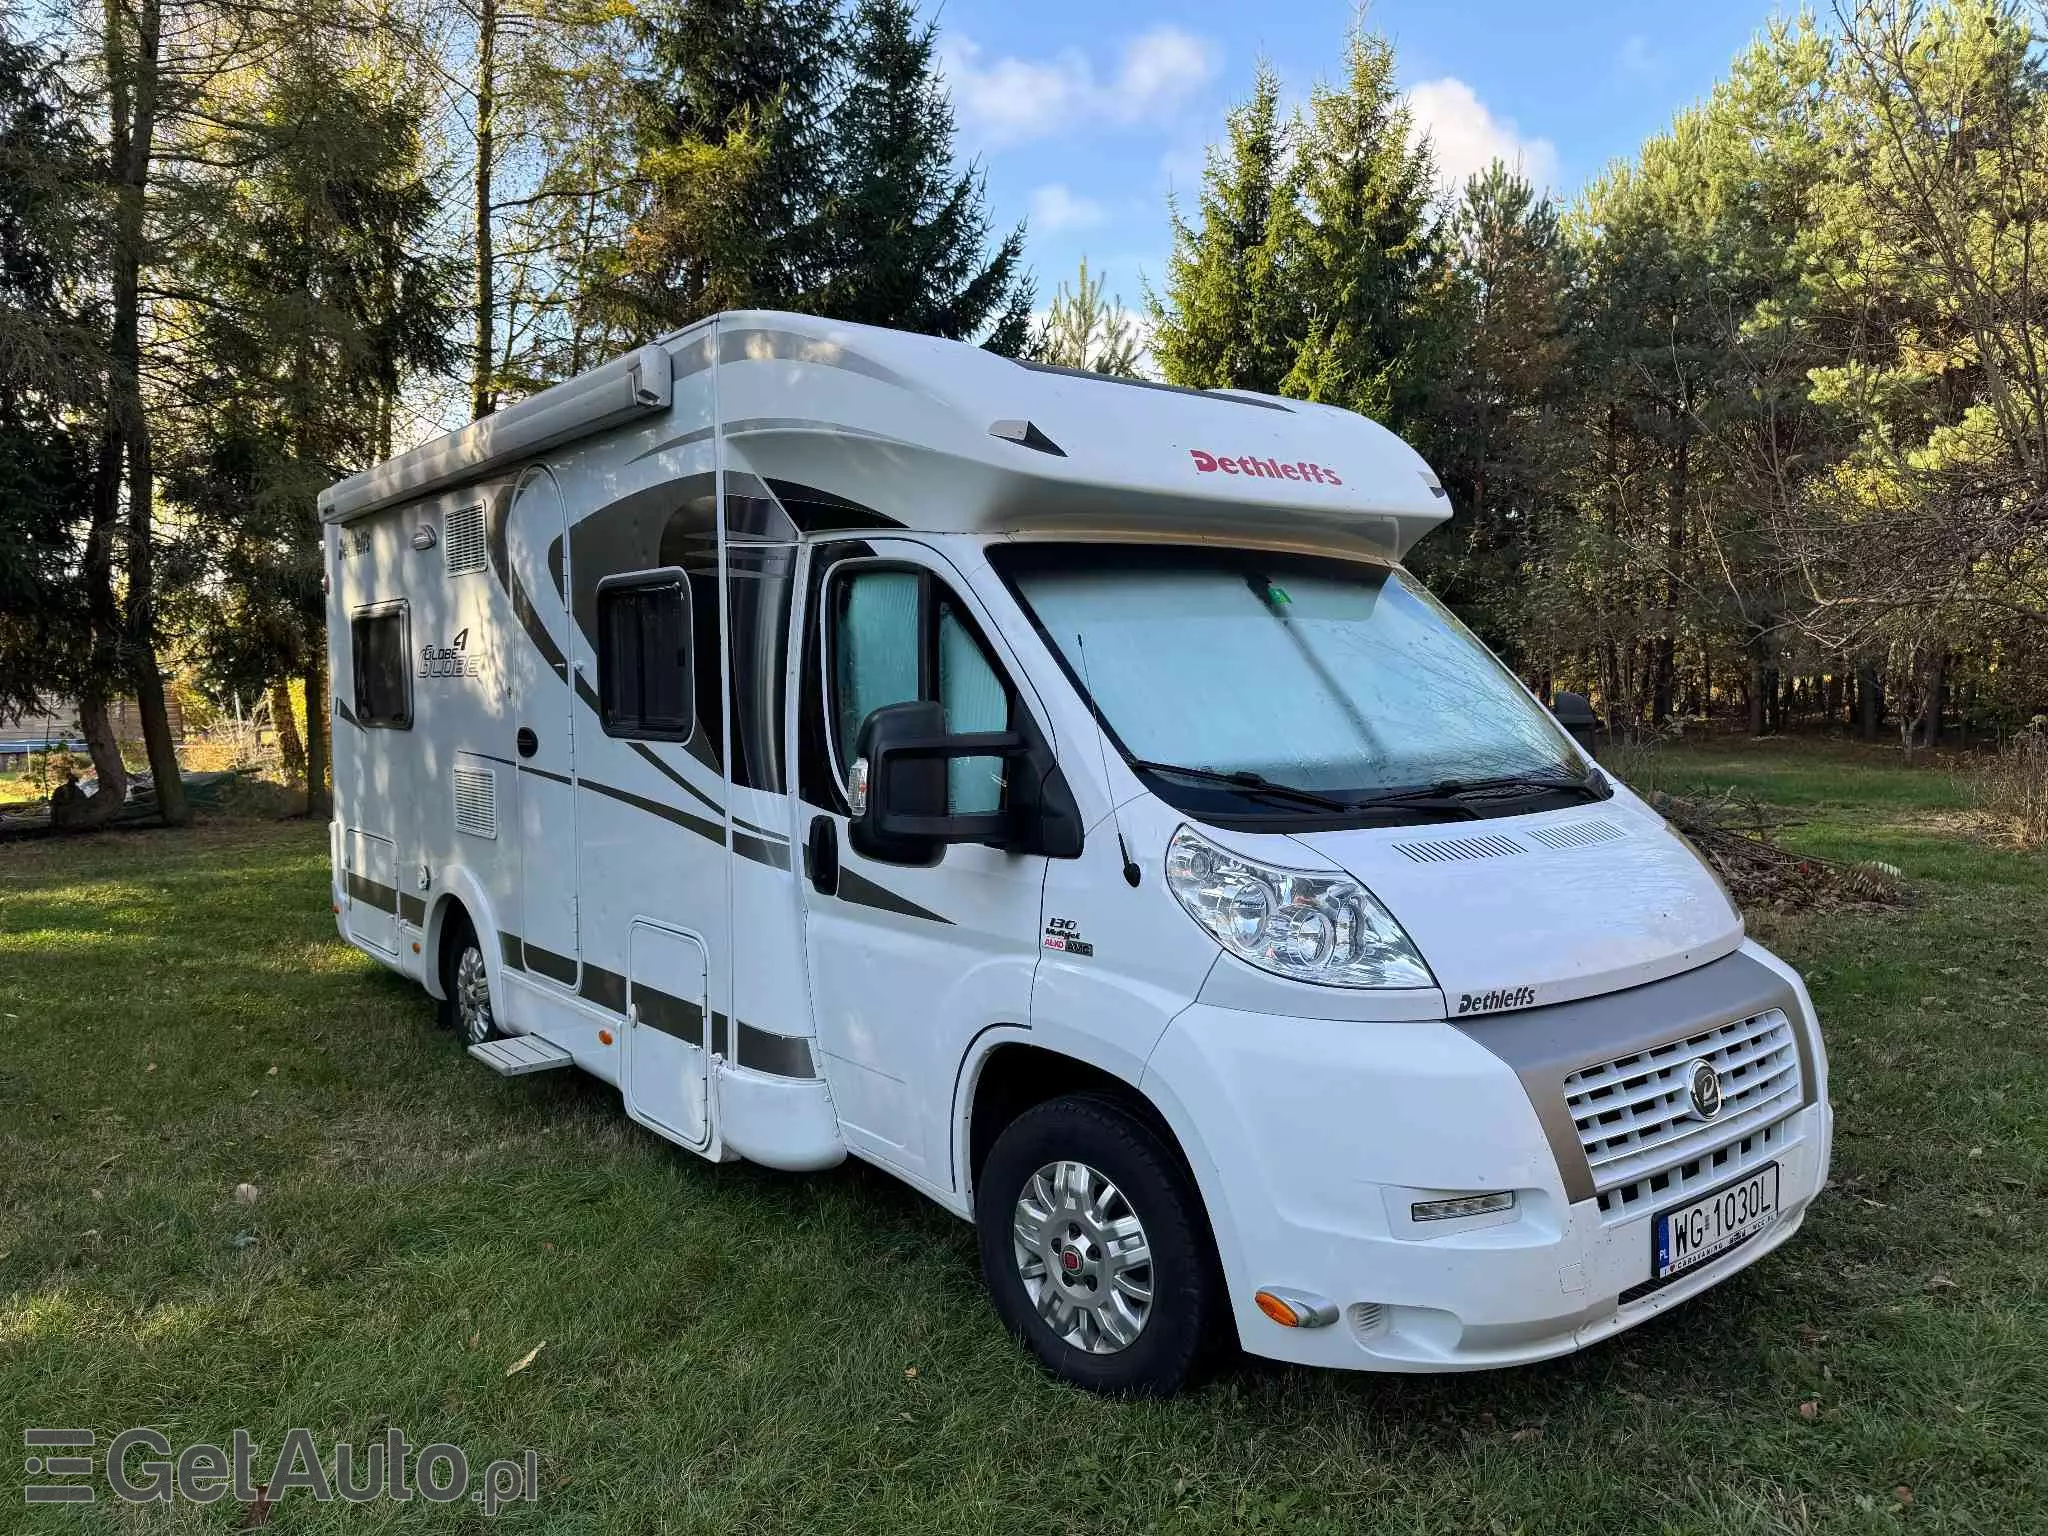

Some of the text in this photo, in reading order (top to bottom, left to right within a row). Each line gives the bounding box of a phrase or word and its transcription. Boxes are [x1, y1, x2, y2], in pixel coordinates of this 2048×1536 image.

[1190, 450, 1342, 486] Dethleffs
[453, 628, 469, 650] 4
[424, 644, 459, 661] GLOBE
[1049, 917, 1077, 930] 130
[1458, 986, 1536, 1014] Dethleffs
[1674, 1208, 1704, 1258] WG
[1659, 1249, 1669, 1260] PL
